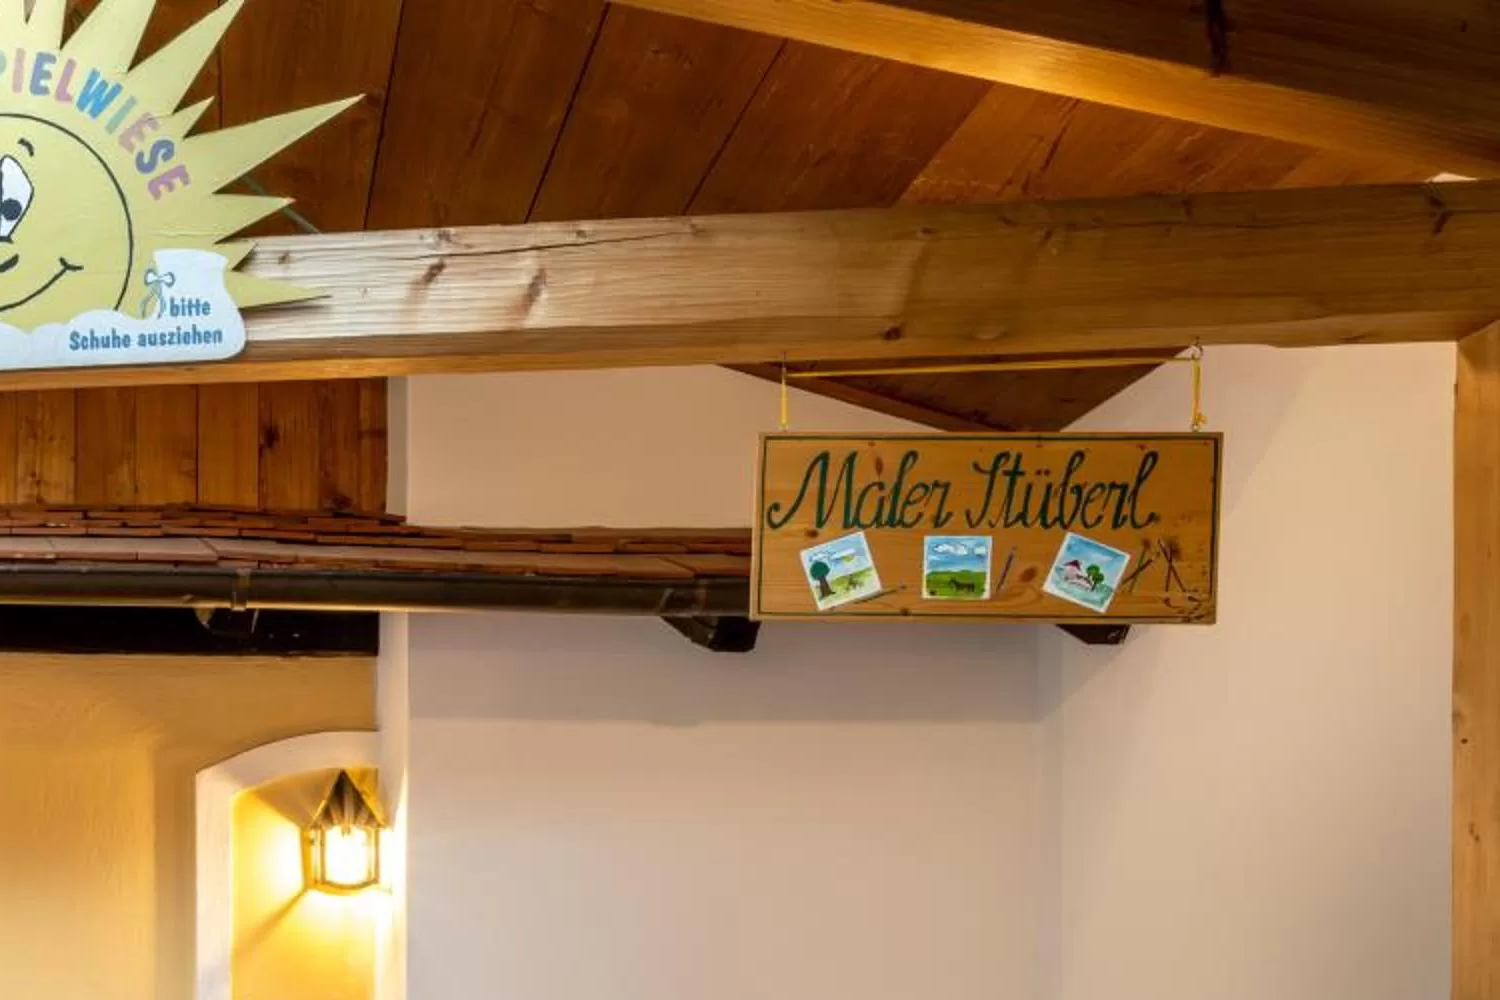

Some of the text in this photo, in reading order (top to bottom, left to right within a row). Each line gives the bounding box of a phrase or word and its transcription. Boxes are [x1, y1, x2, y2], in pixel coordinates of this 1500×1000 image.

[169, 297, 212, 317] bitte
[69, 324, 224, 350] Schuhe ausziehen
[766, 450, 1160, 530] Maler Stüberl
